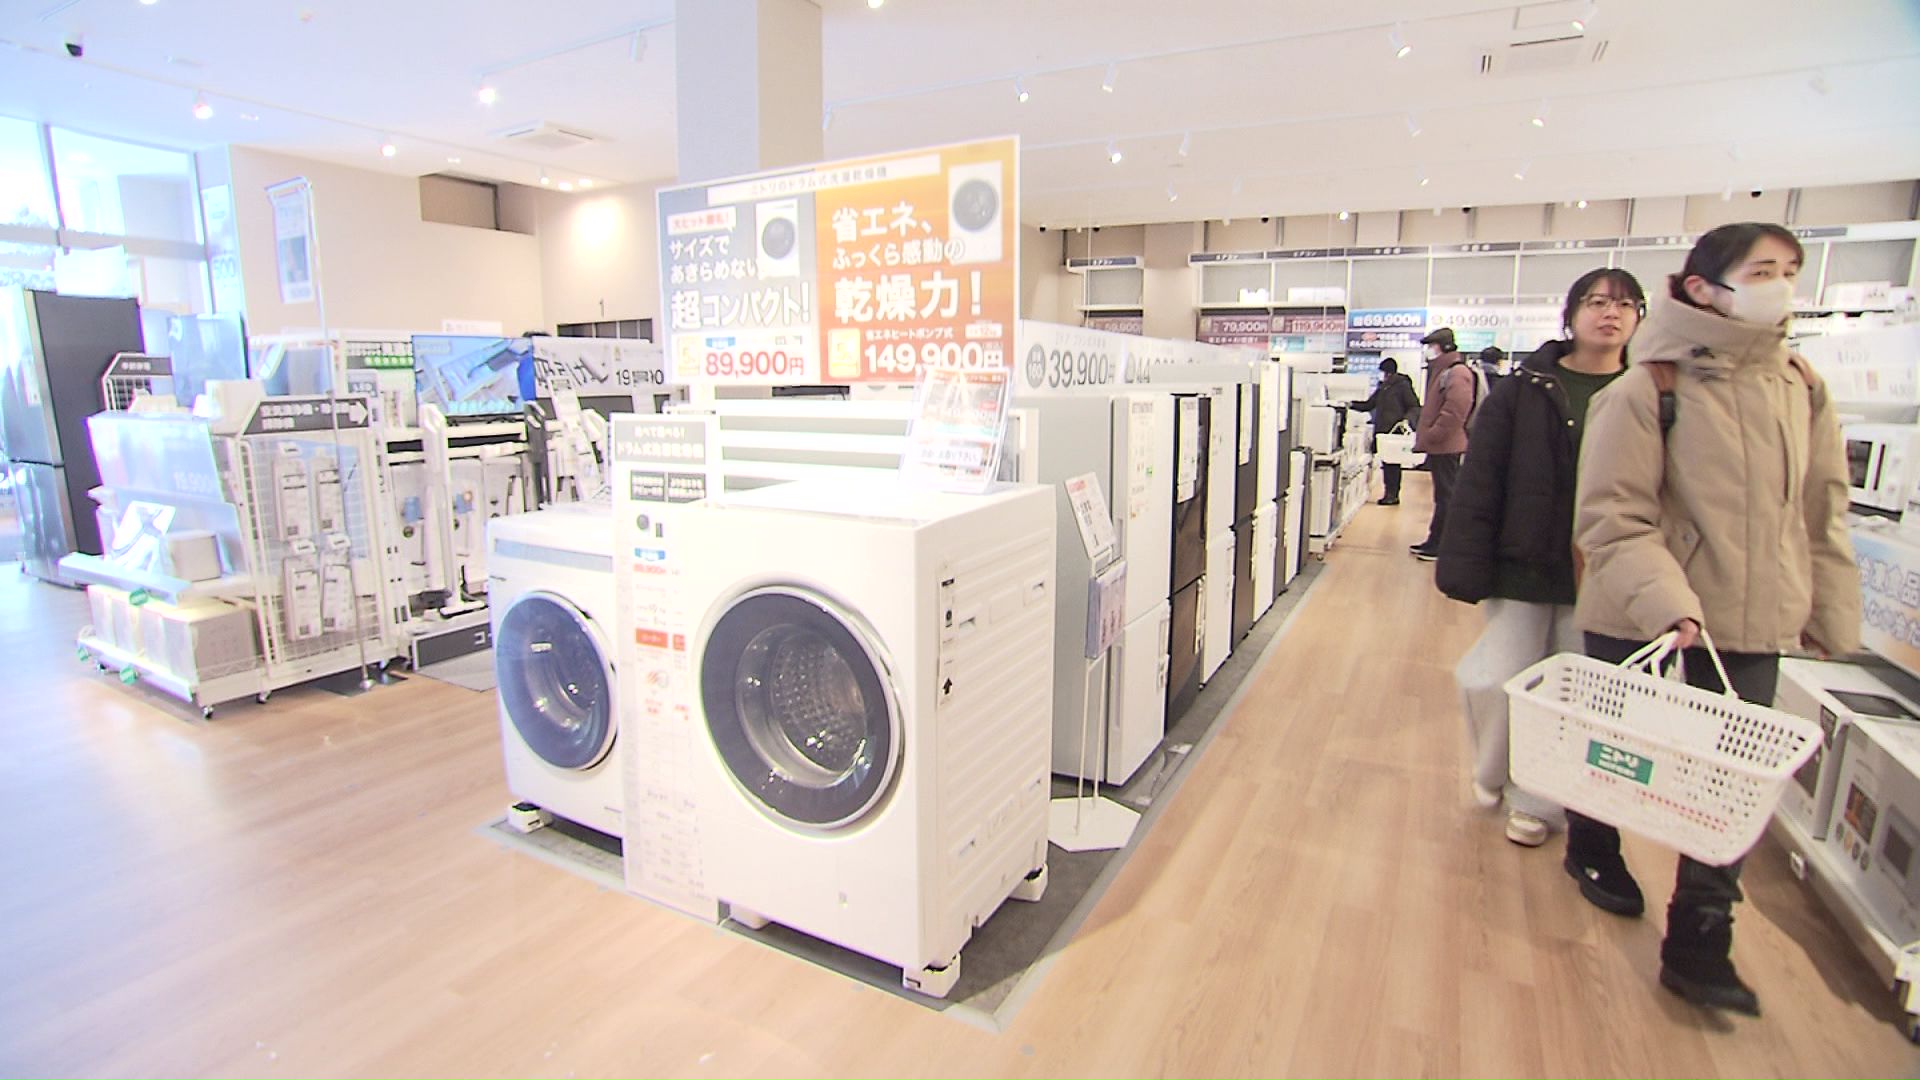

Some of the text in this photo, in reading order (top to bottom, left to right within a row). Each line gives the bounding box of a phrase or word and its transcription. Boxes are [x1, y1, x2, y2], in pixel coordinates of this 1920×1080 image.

[832, 201, 933, 243] 省エネ、
[669, 235, 731, 260] サイズで
[832, 236, 965, 270] ふっくら感動の
[670, 258, 760, 285] あきらめない
[671, 282, 810, 329] 超コンパクト!
[833, 269, 982, 324] 乾燥力!
[705, 350, 804, 379] 89,900円
[1599, 745, 1640, 768] ニトリ
